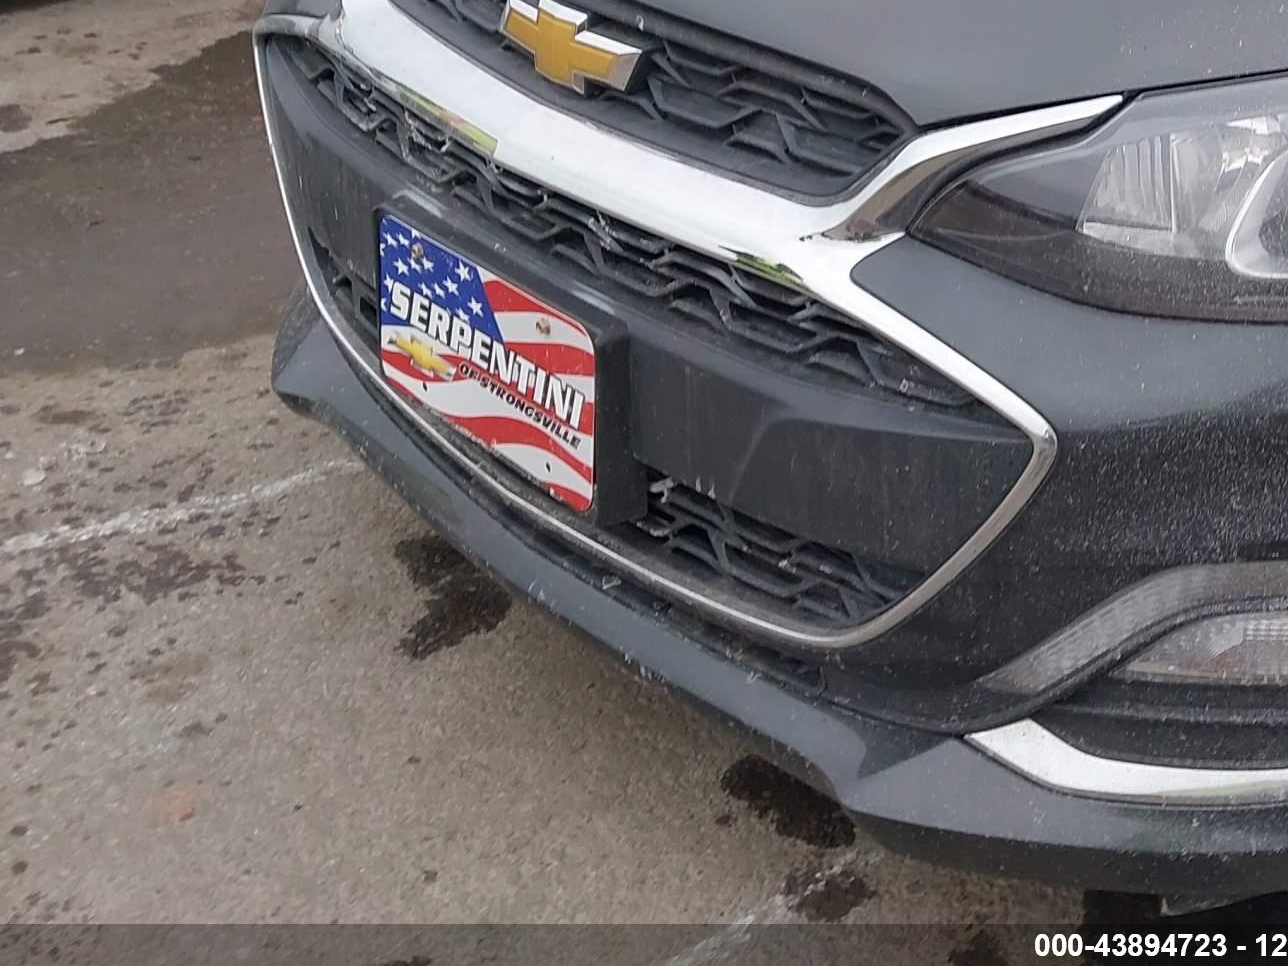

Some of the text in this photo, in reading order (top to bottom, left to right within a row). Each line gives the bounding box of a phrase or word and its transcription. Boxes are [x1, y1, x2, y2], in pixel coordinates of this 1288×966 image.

[390, 281, 585, 430] SERPENTINI
[459, 362, 581, 450] OF STRONGSVILLE
